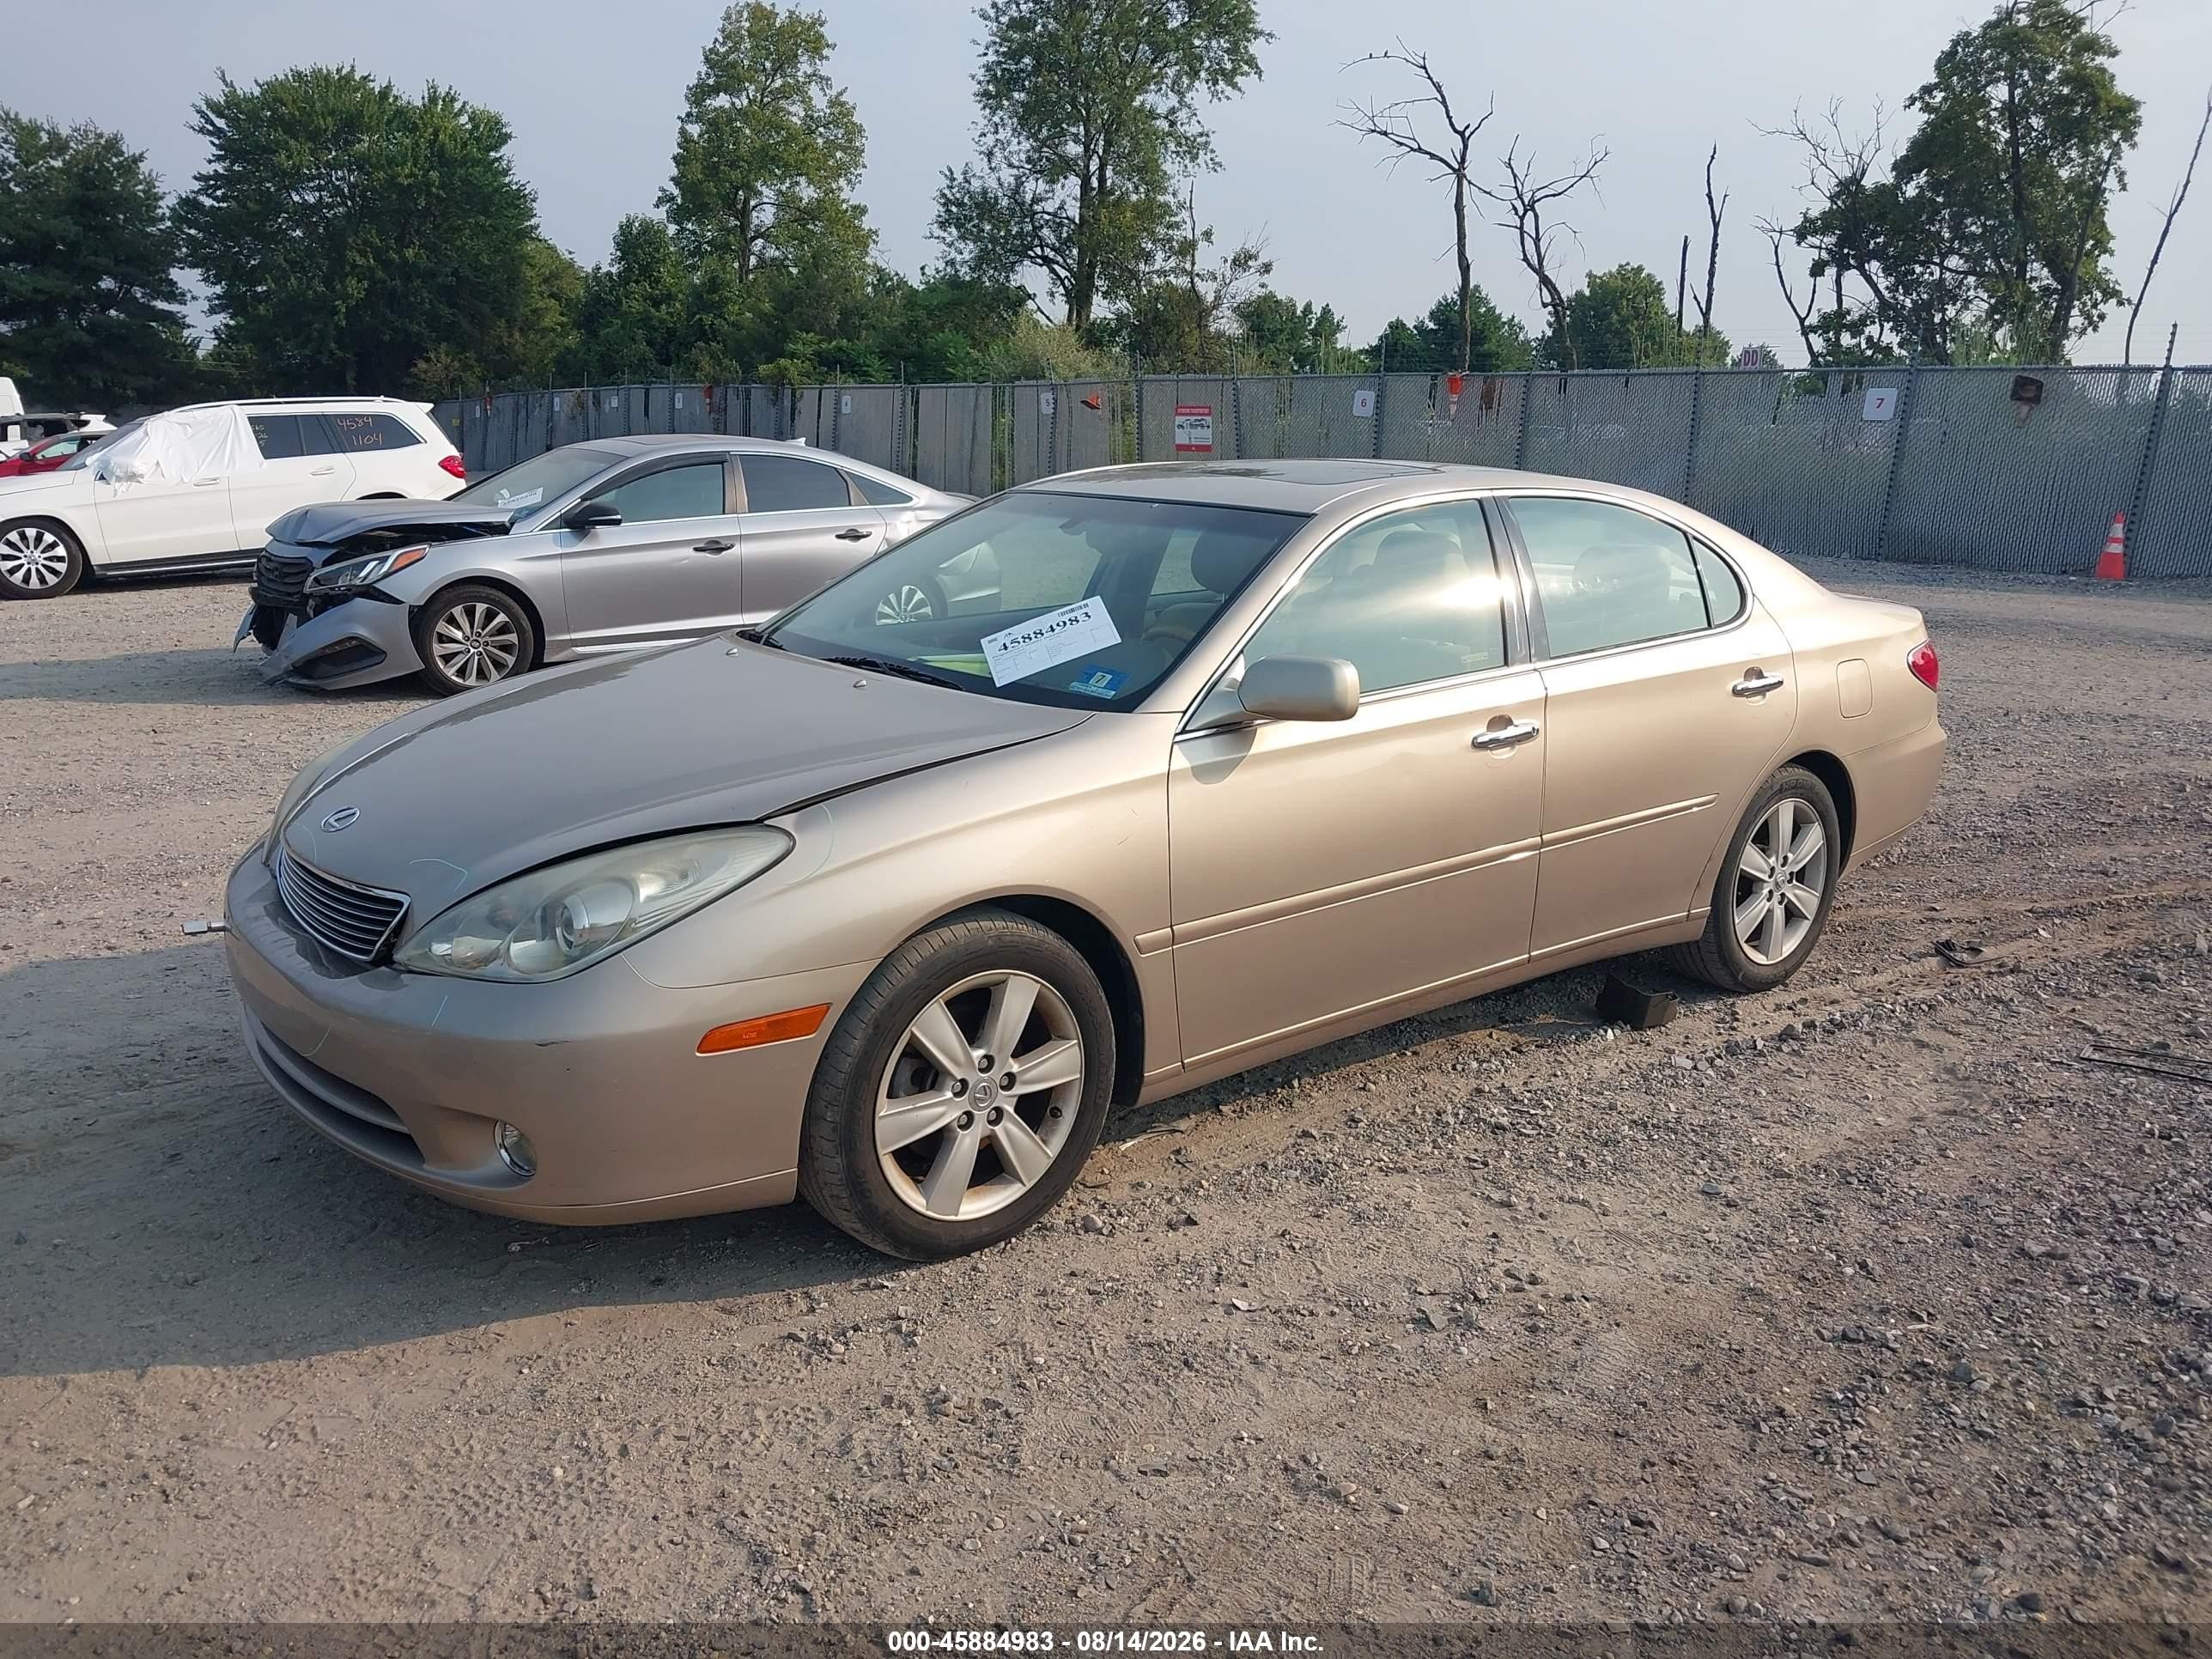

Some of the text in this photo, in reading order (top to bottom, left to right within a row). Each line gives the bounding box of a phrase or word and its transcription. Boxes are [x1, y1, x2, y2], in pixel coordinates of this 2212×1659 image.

[1045, 398, 1050, 407] 5
[1360, 398, 1368, 408] 6
[1875, 398, 1886, 409] 7
[352, 433, 382, 446] 1104
[997, 611, 1092, 653] 45884983
[1096, 674, 1107, 684] 7
